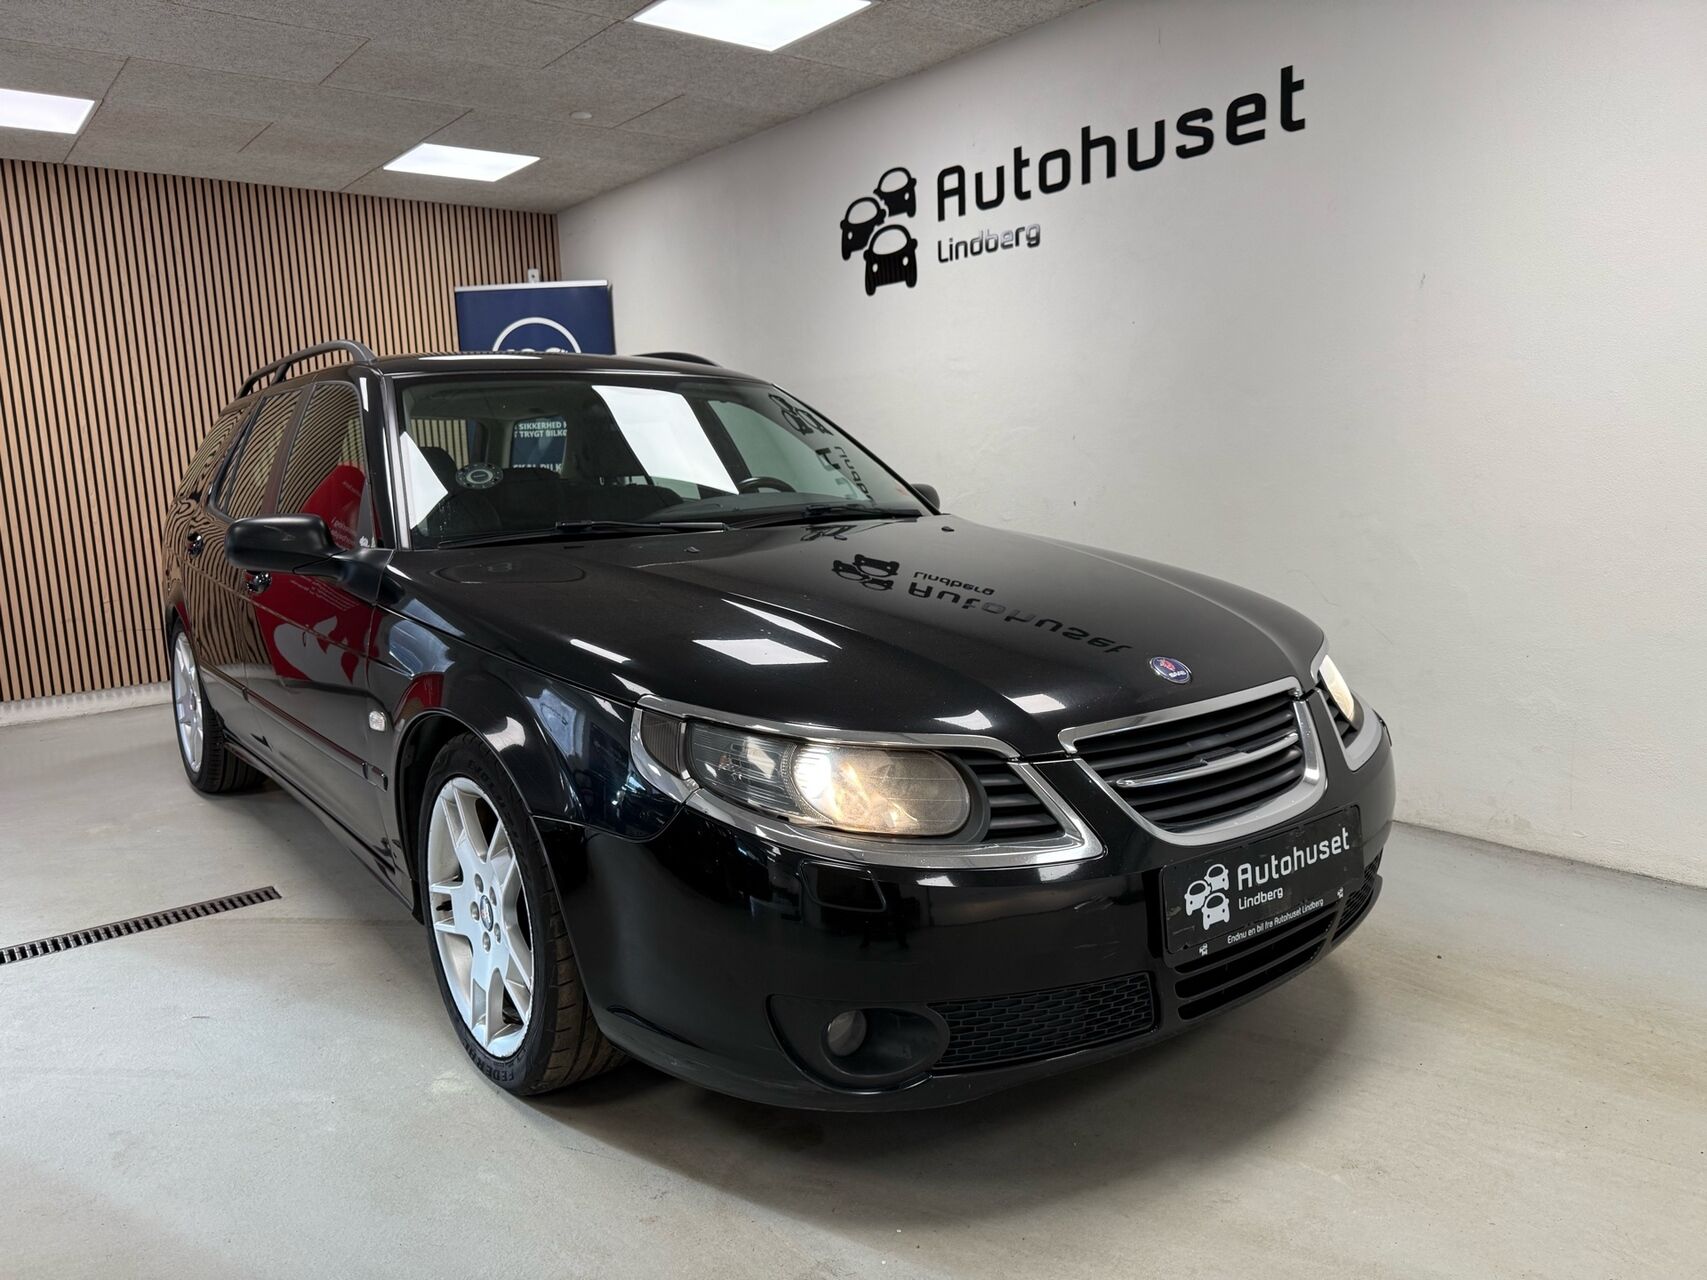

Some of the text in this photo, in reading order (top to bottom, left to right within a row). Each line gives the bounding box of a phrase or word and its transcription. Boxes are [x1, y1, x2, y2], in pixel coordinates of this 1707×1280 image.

[937, 65, 1306, 222] Autohuset
[937, 222, 1041, 263] Lindberg
[518, 421, 562, 430] SIKKERHED
[519, 430, 545, 438] TRYGT
[1237, 827, 1350, 891] Autohuset
[1238, 886, 1284, 910] Lindberg
[1227, 898, 1324, 944] Endnu en bil fra Autohuset Lindberg
